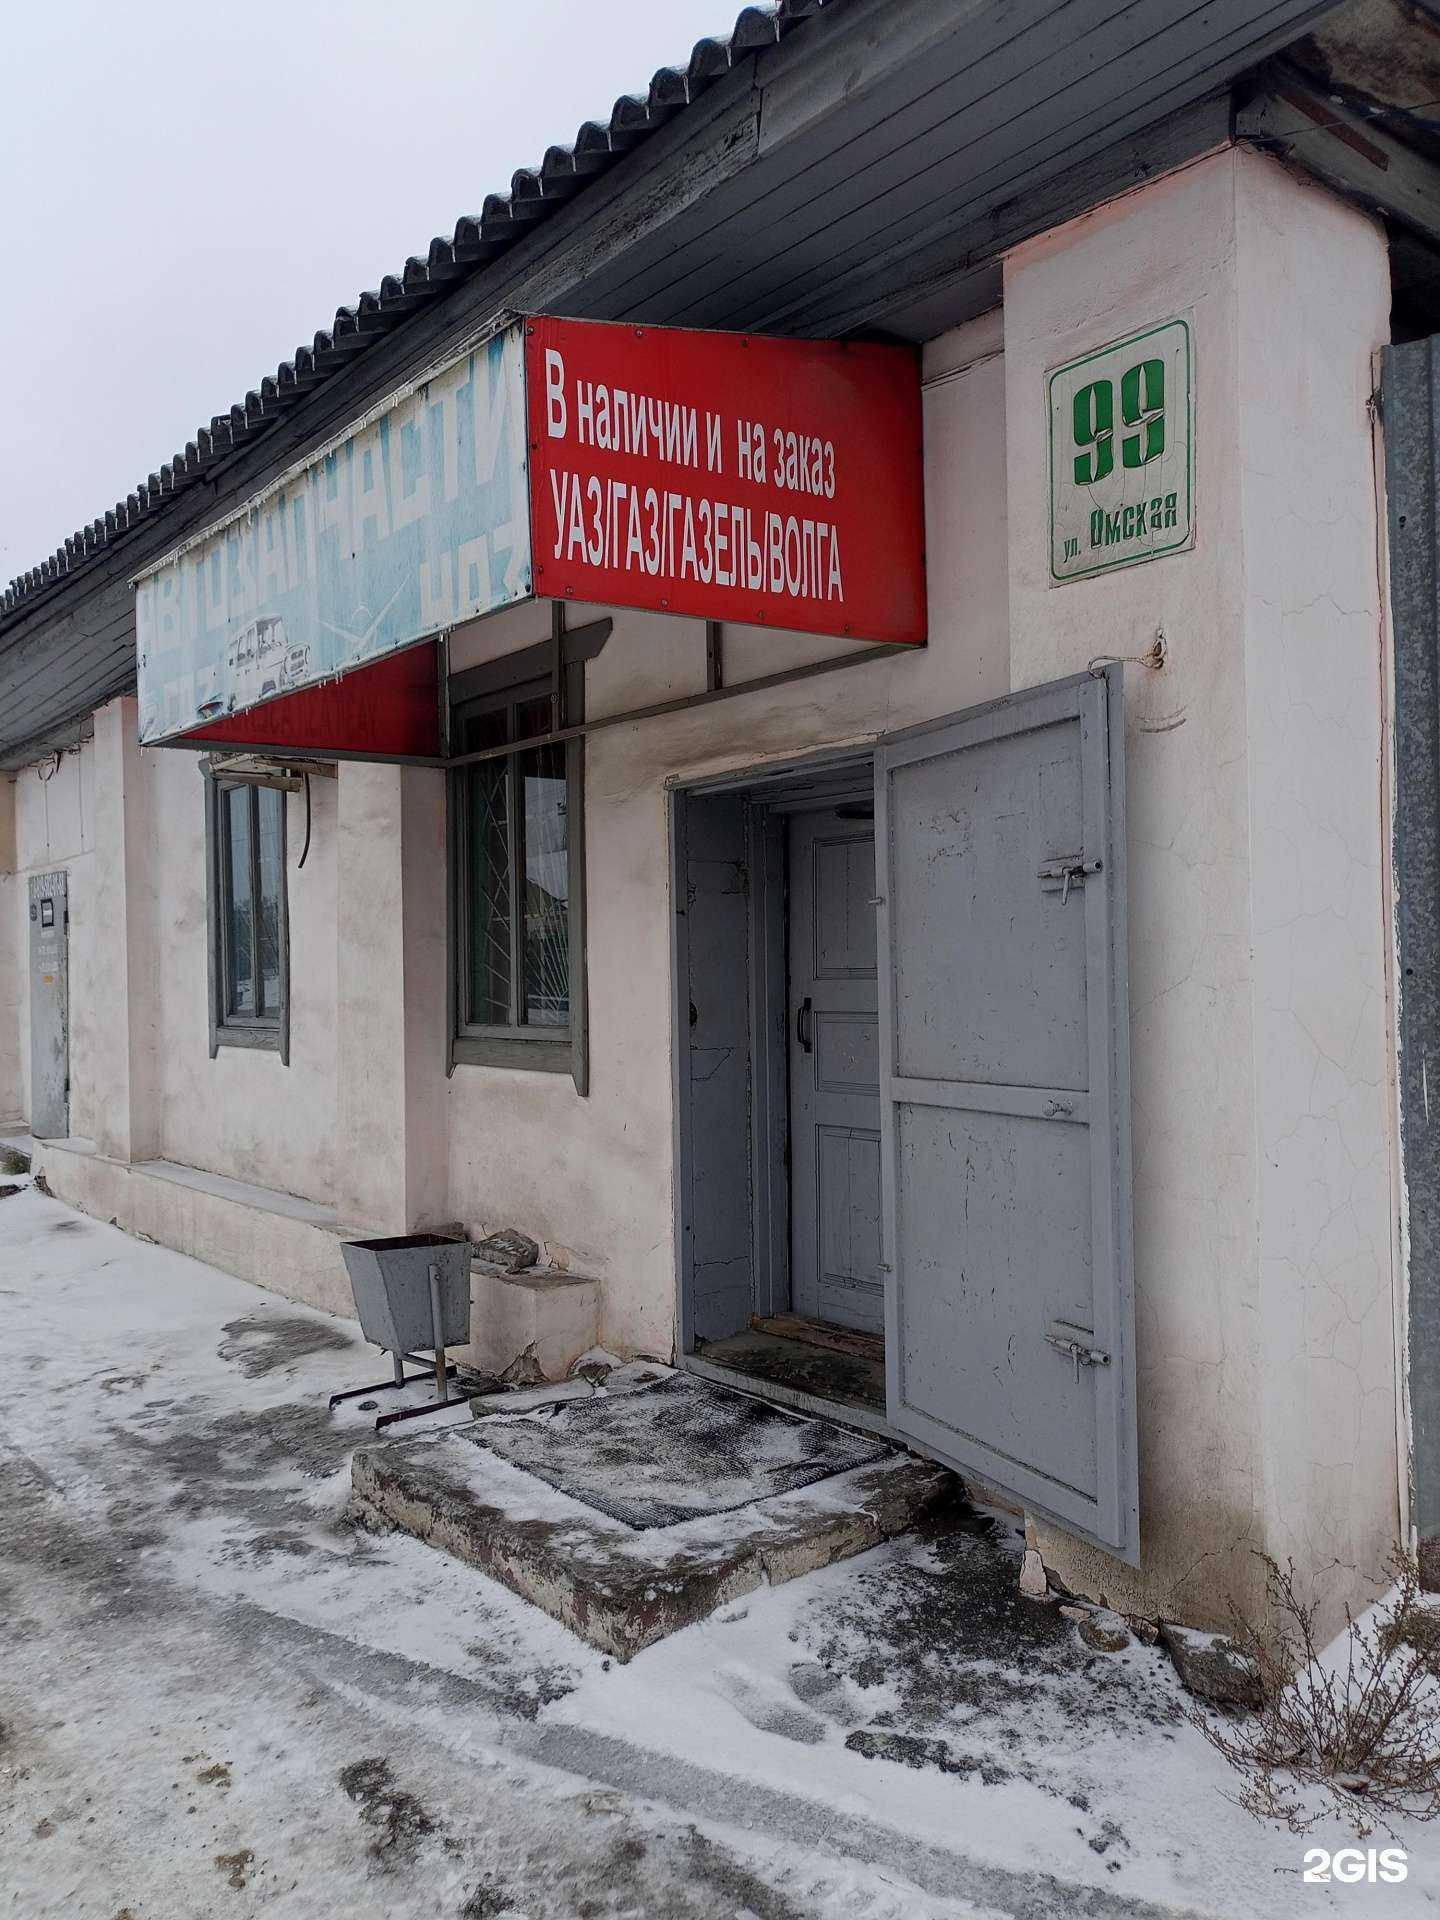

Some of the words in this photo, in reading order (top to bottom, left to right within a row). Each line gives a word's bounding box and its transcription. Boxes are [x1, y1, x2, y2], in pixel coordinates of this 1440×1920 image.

[545, 348, 568, 439] В
[576, 379, 699, 468] наличии
[706, 411, 723, 474] и
[737, 418, 767, 483] на
[773, 428, 836, 499] заказ
[1073, 359, 1165, 486] 99
[550, 469, 845, 602] УАЗ/ГАЗ/ГАЗЕЛЬ/ВОЛГА
[1063, 536, 1082, 564] ул.
